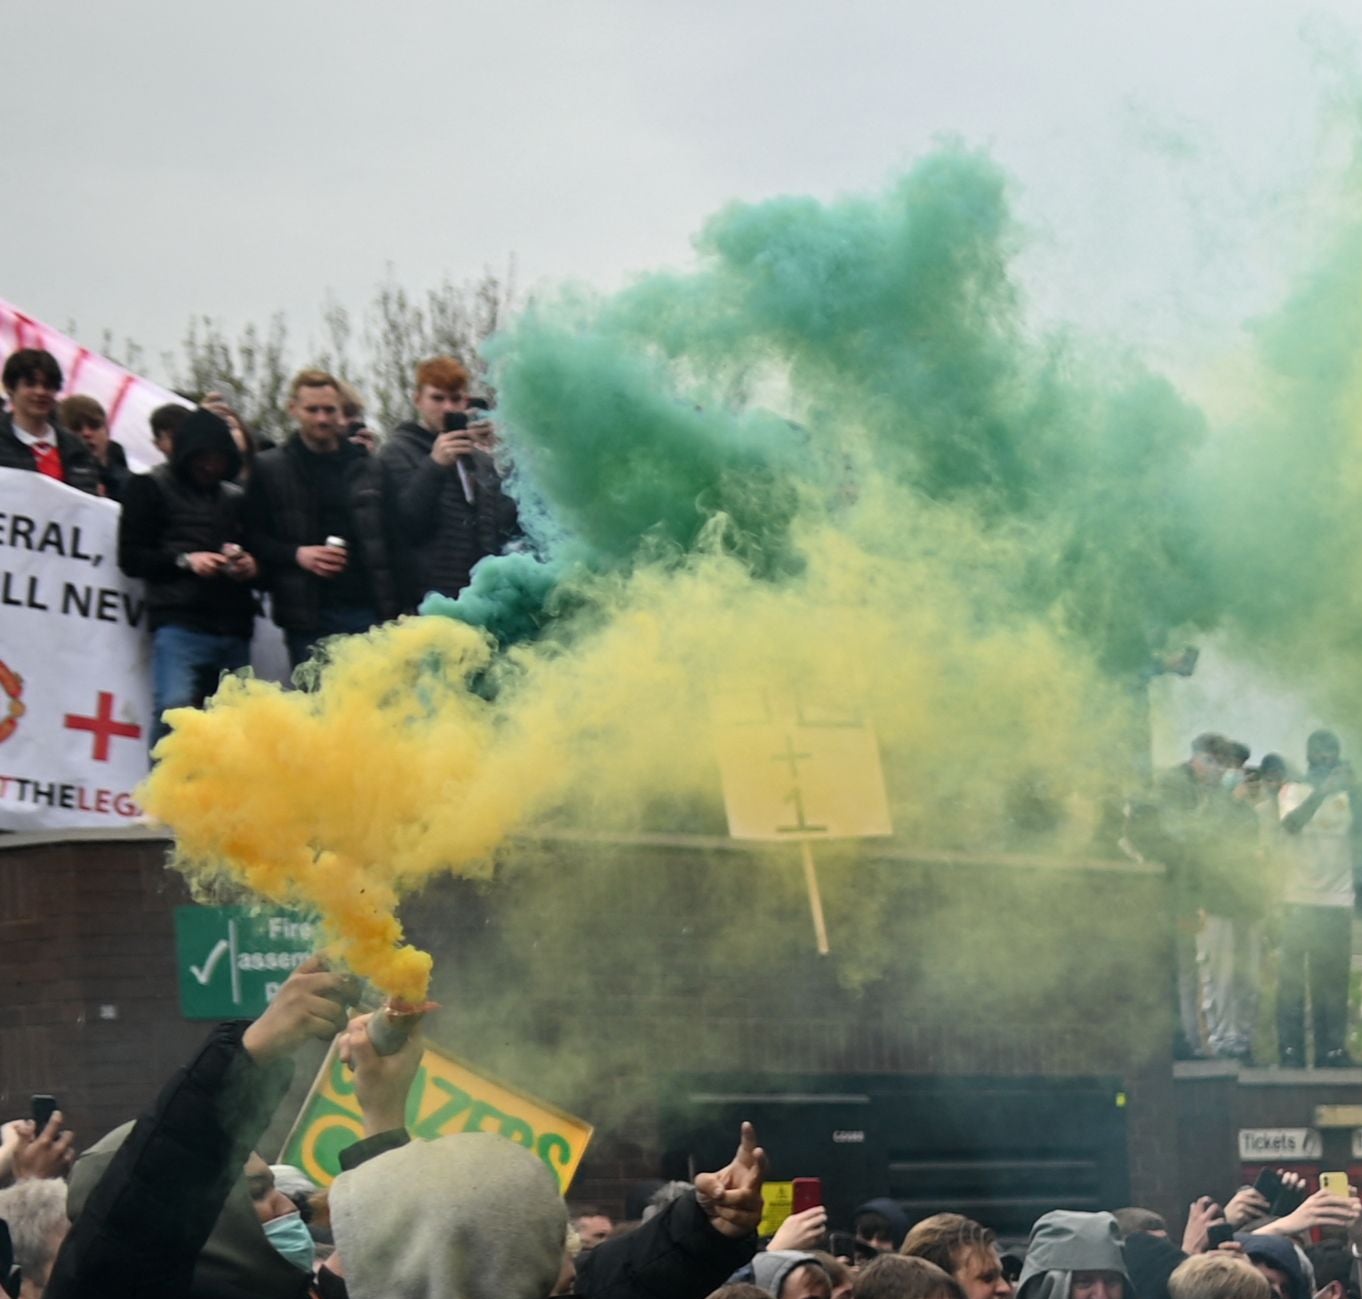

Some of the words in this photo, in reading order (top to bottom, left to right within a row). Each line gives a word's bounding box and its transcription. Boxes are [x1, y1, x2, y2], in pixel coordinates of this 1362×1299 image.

[0, 513, 104, 566] RAL,
[0, 774, 143, 817] TTHELEG
[268, 917, 315, 940] Fire
[236, 951, 313, 971] assem
[1244, 1133, 1296, 1150] Tickets
